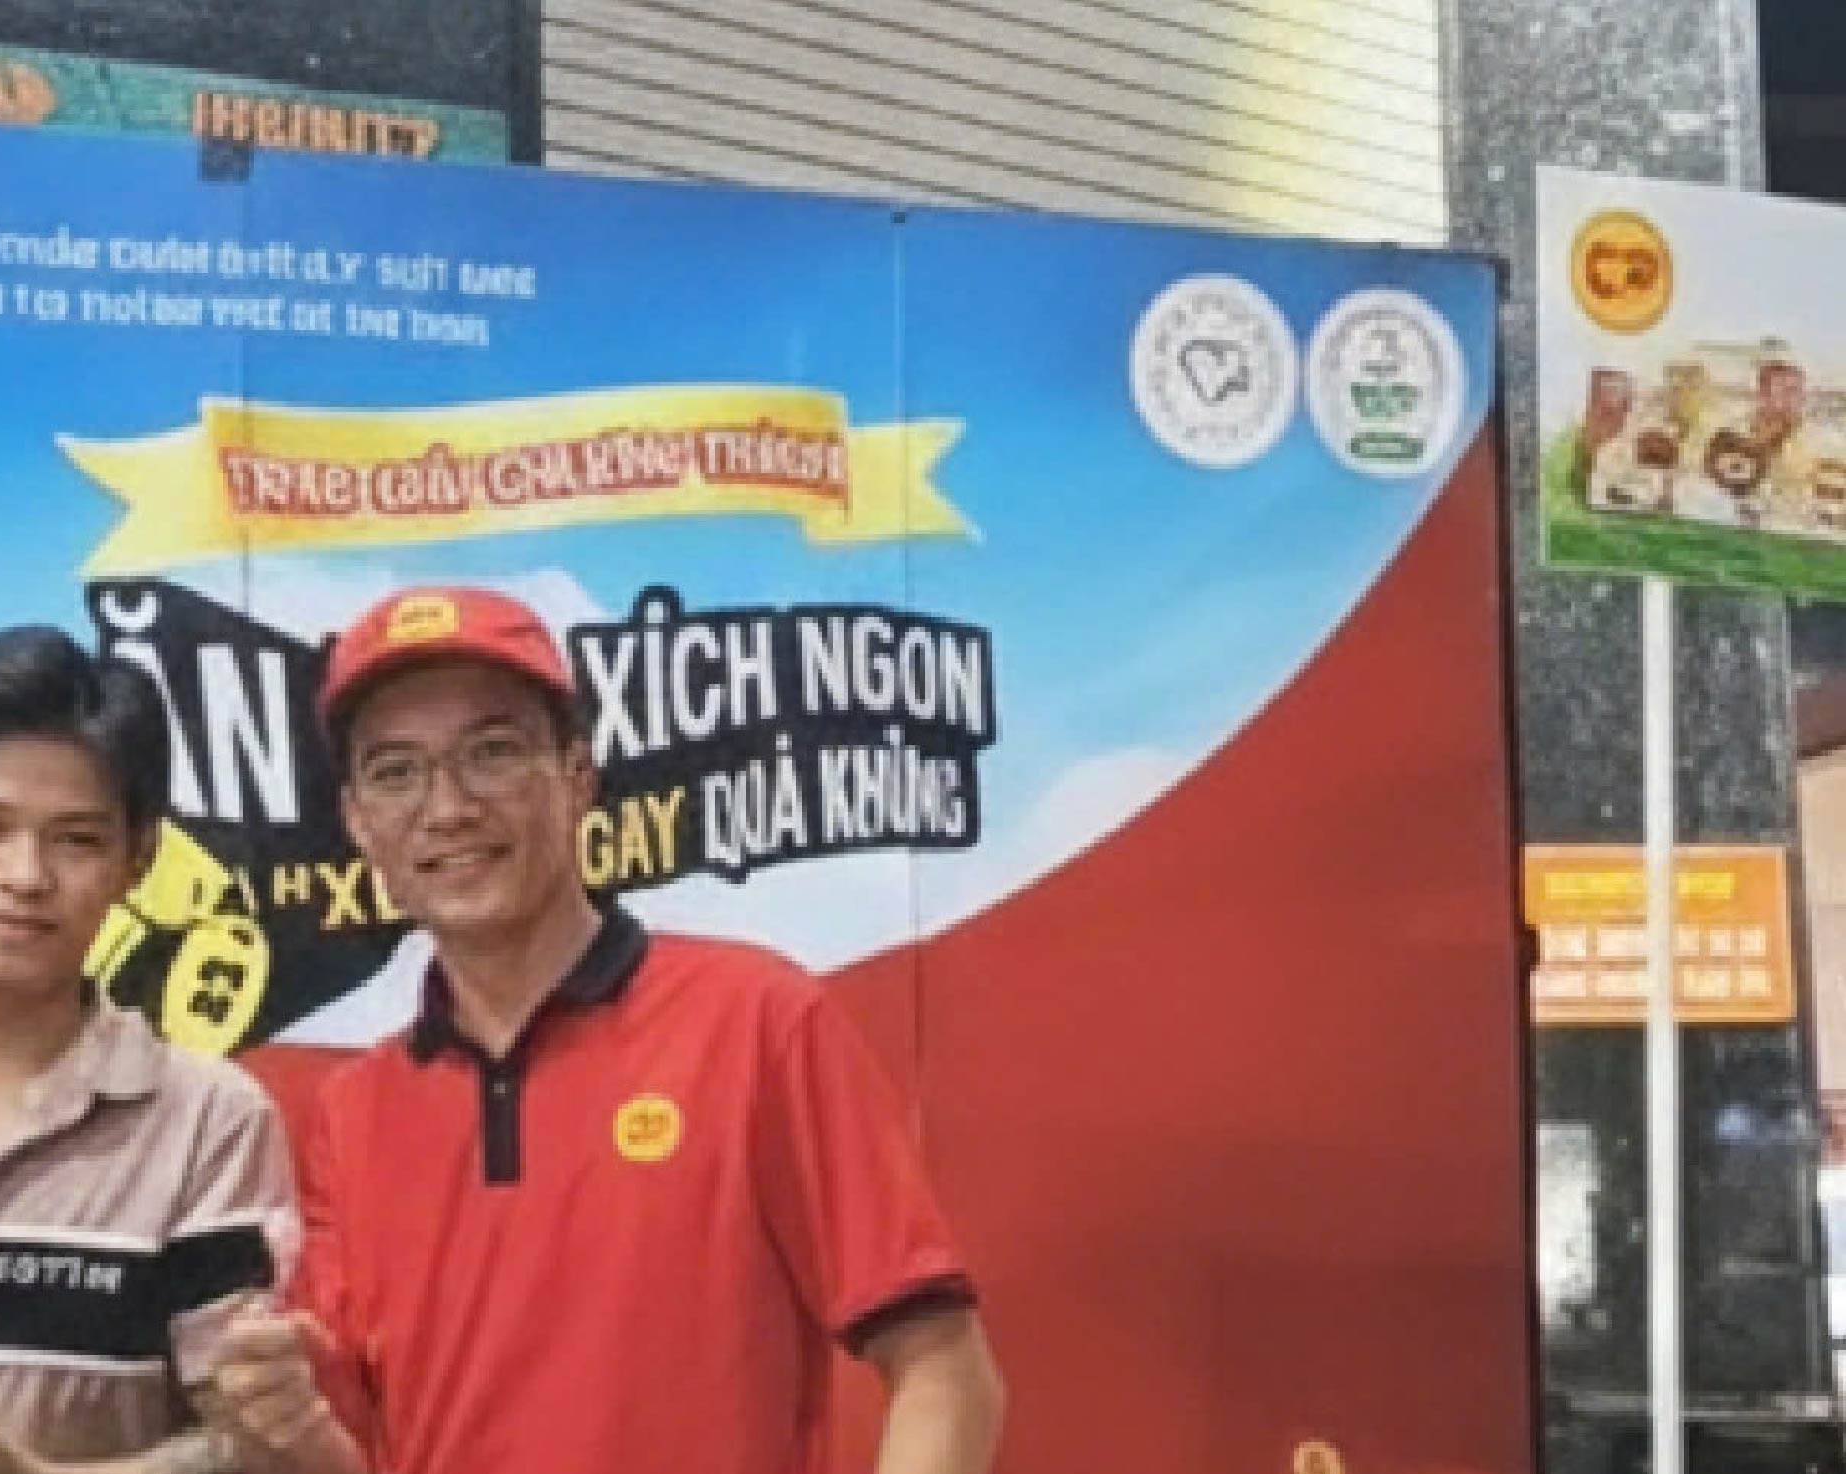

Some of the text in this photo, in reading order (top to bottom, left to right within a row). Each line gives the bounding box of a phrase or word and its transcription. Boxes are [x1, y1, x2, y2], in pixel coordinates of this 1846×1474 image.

[580, 600, 778, 766] XÍCH
[796, 616, 986, 736] NGON
[576, 786, 685, 888] GAY
